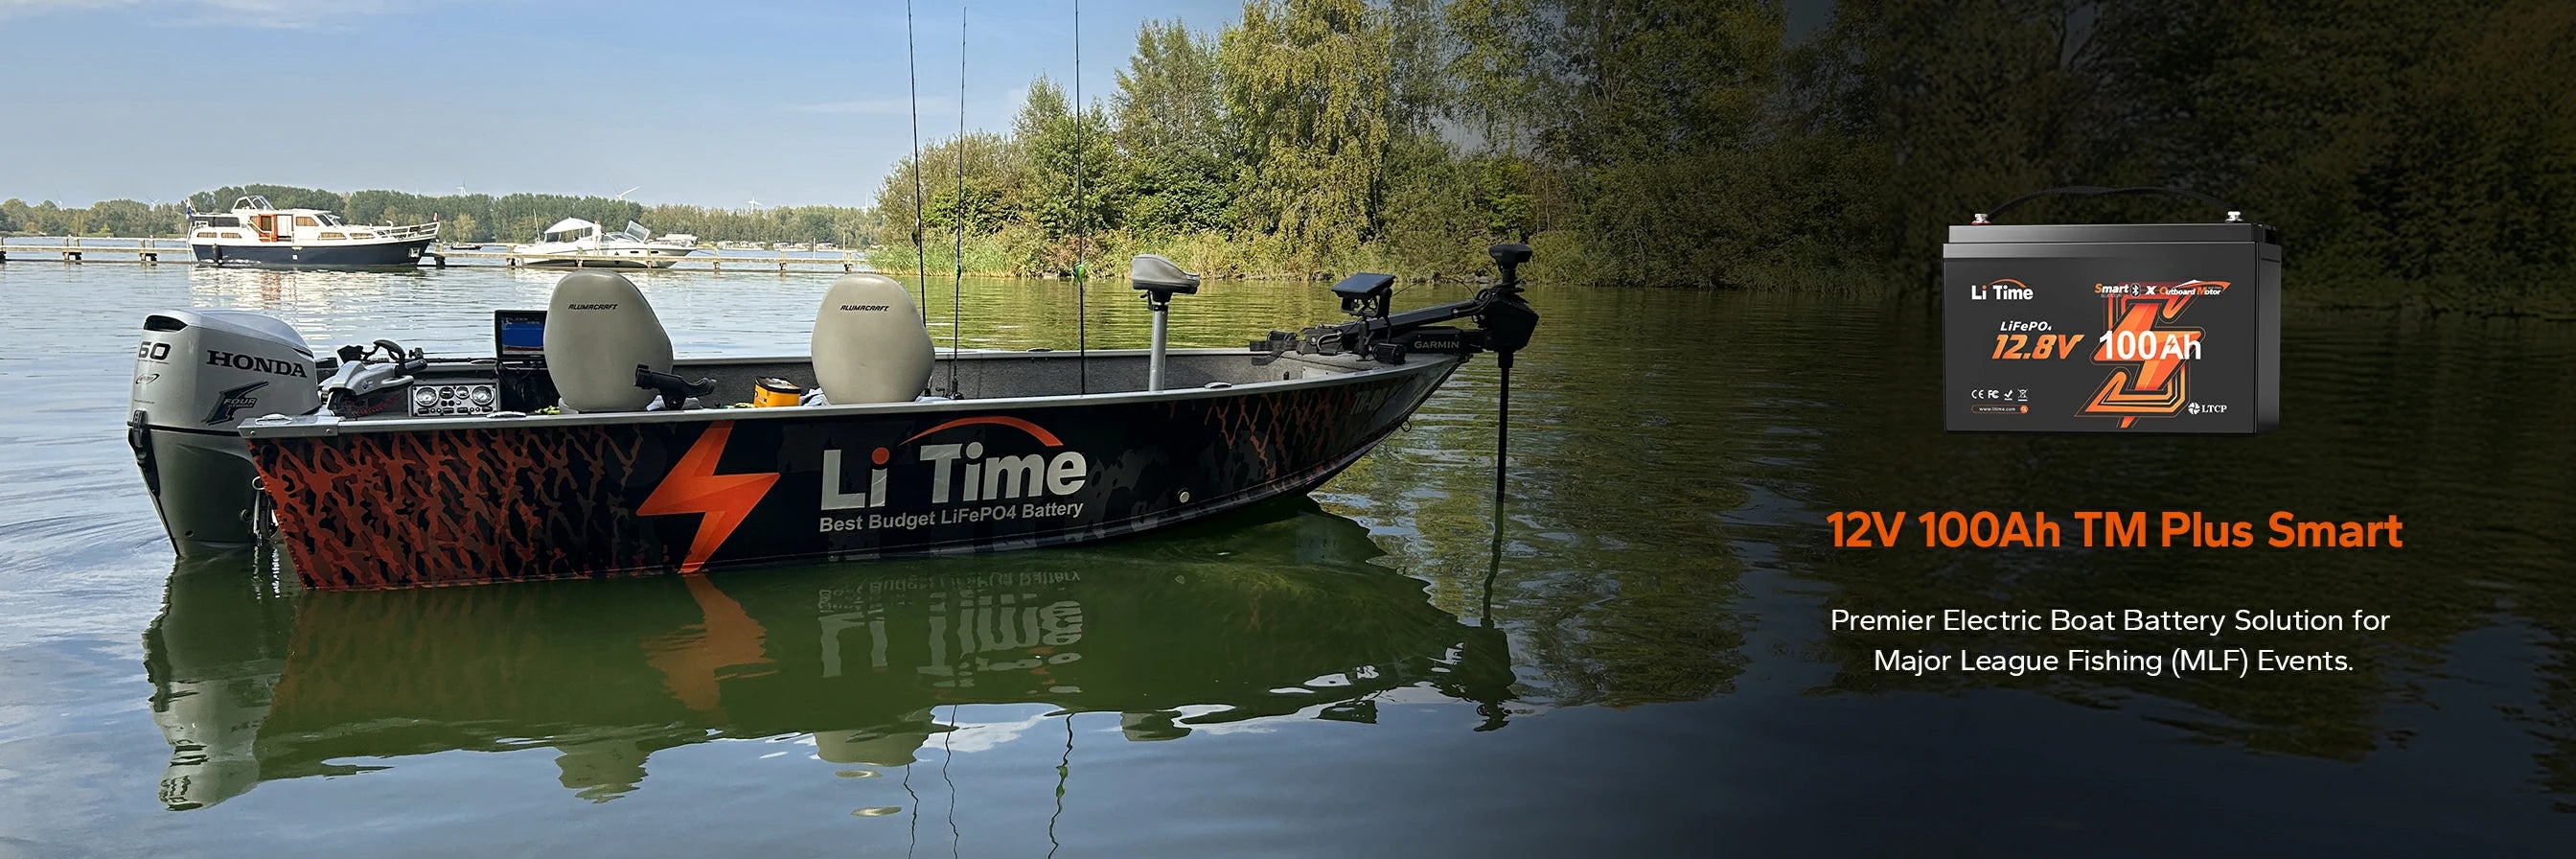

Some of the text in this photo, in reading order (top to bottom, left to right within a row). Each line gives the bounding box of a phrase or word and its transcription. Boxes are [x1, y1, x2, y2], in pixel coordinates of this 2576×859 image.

[1971, 285, 2034, 300] Li Time
[2094, 283, 2129, 293] Smart
[2159, 287, 2196, 295] Outboard
[2196, 287, 2221, 295] Motor
[1414, 340, 1460, 349] GARMIN
[1992, 334, 2085, 360] 12.8V
[206, 349, 308, 379] HONDA
[2201, 404, 2228, 413] LTCP
[820, 441, 1087, 511] Li Time
[819, 501, 1084, 532] Best Budget LiFePO4 Battery
